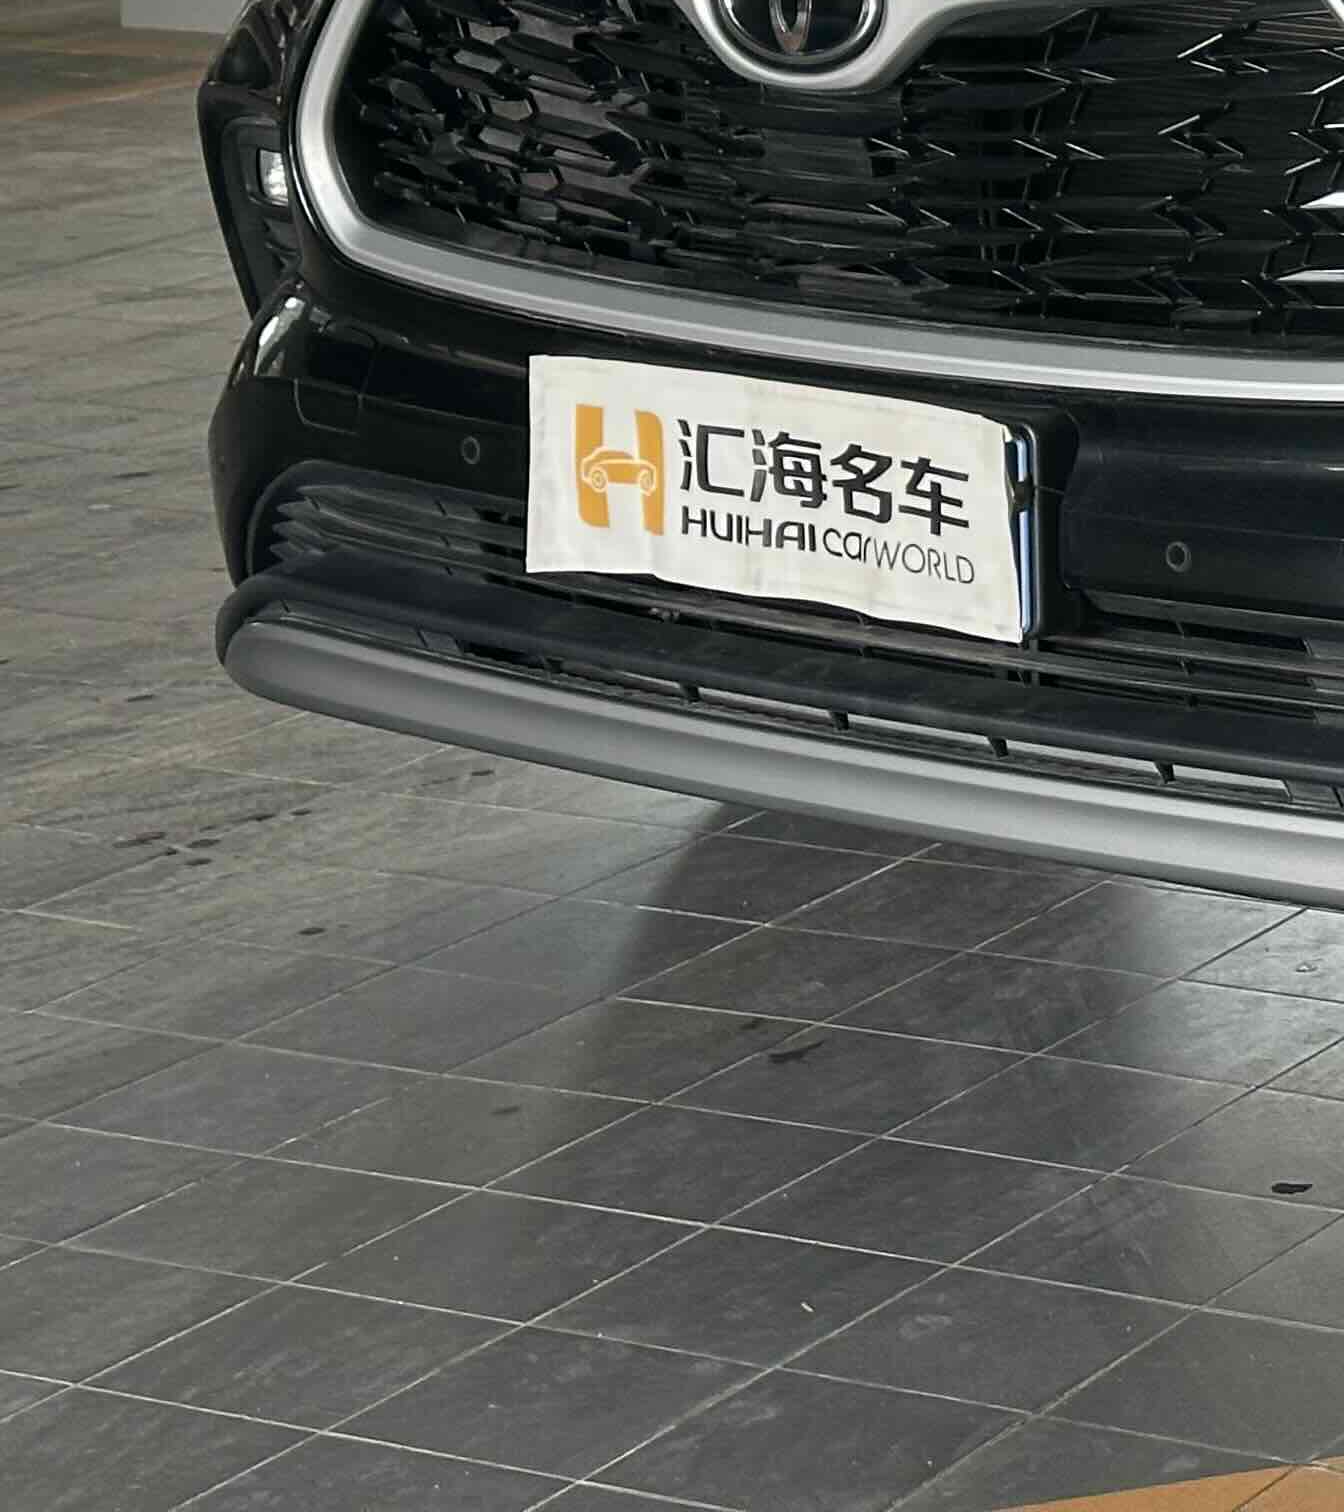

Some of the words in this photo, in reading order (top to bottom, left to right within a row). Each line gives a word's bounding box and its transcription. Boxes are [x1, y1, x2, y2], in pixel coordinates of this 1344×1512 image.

[678, 419, 969, 536] 汇海名车
[681, 505, 817, 552] HUIHAI
